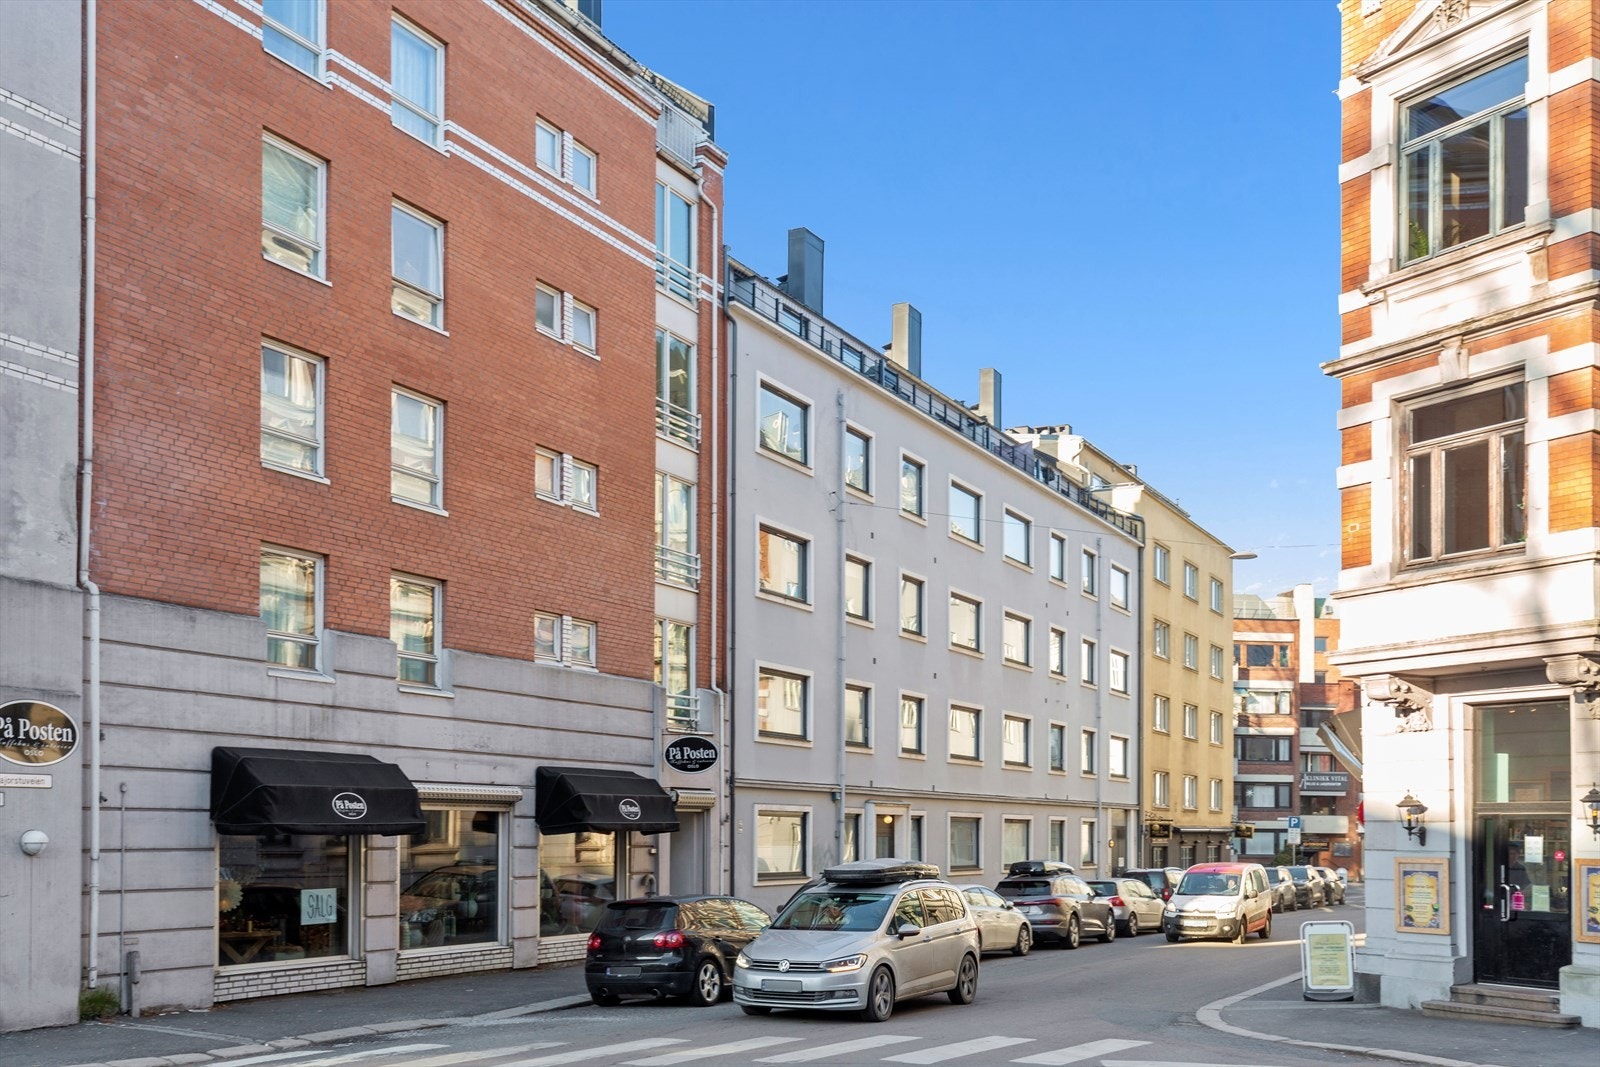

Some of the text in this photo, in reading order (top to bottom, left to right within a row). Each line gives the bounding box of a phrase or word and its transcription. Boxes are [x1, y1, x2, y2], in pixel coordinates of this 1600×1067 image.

[18, 718, 73, 742] Posten
[669, 746, 716, 760] På Posten
[1290, 817, 1299, 827] P
[306, 894, 333, 919] SALG
